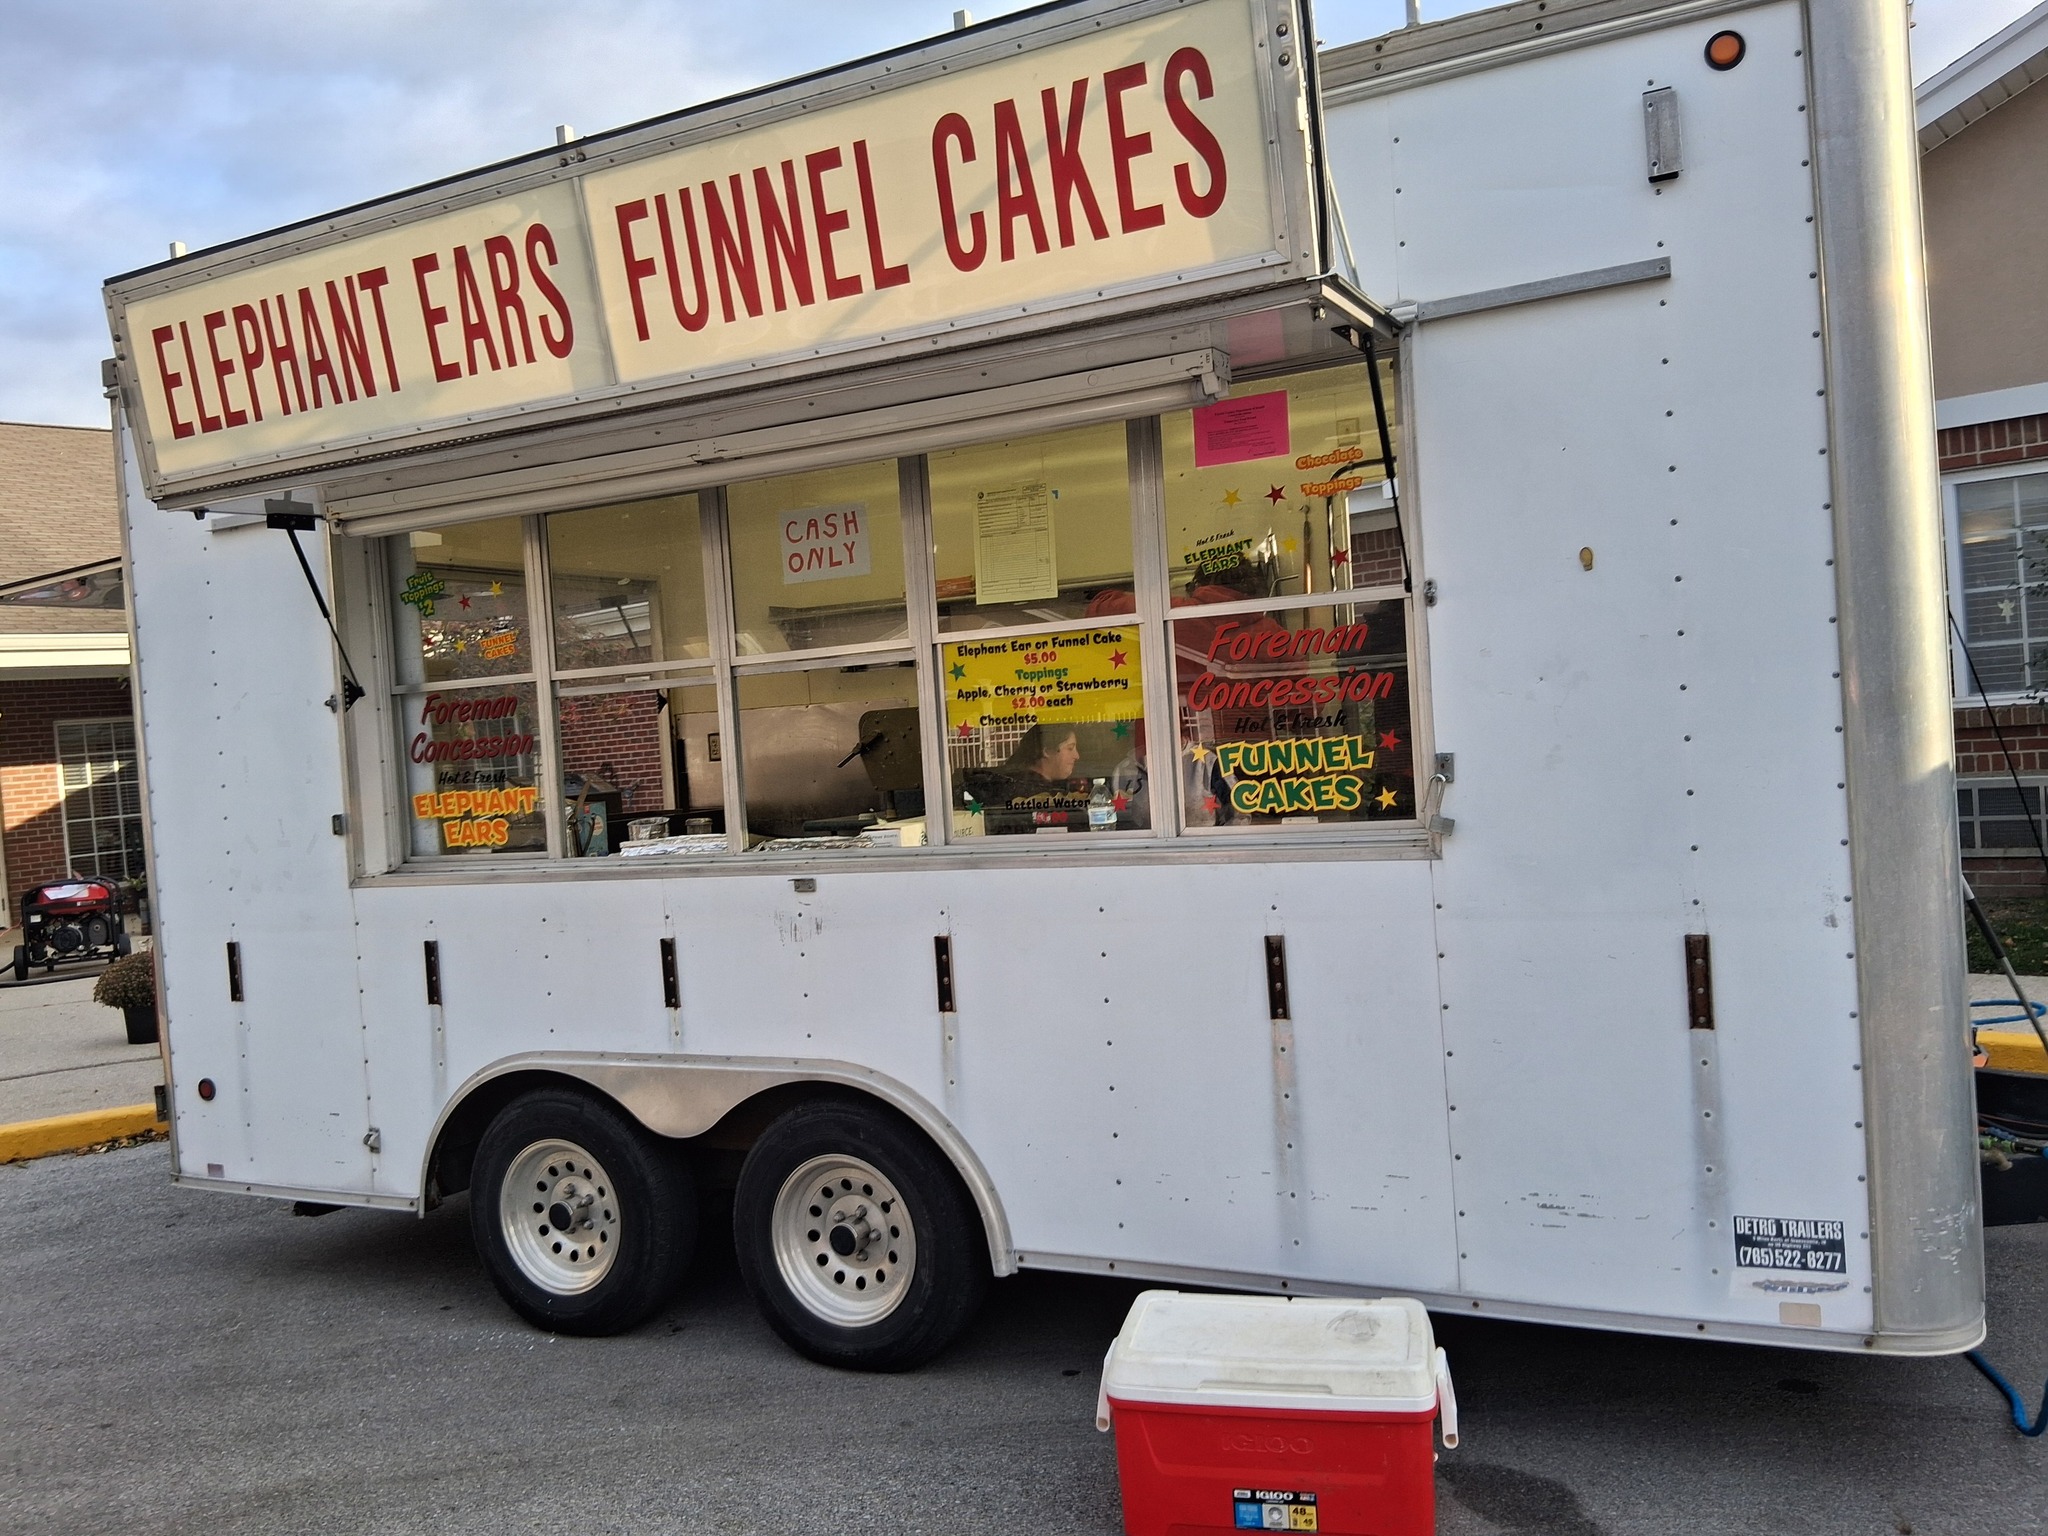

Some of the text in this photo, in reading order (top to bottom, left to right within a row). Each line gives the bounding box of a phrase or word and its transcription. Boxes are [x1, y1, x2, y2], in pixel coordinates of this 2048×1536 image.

[616, 47, 1227, 341] FUNNEL CAKES
[152, 224, 574, 439] ELEPHANT EARS
[1296, 446, 1363, 470] Chocolate
[1300, 477, 1362, 497] Toppings
[786, 510, 859, 543] CASH
[788, 541, 855, 573] ONLY
[1184, 538, 1253, 565] ELEPHANT
[1201, 554, 1240, 576] EARS
[400, 579, 445, 605] Toppings
[407, 571, 433, 590] Fruit
[480, 632, 518, 650] FUNNEL
[484, 644, 515, 660] CAKES
[957, 631, 1122, 659] Elephant Ear or Funnel Cake
[1206, 621, 1368, 663] Foreman
[1024, 651, 1057, 666] $5.00
[1015, 666, 1069, 682] Toppings
[957, 677, 1129, 701] Apple, Cherry or Strawberry
[1188, 666, 1395, 711] Concession
[422, 693, 518, 725] Foreman
[1012, 695, 1073, 709] $2.00 each
[980, 713, 1037, 727] Chocolate
[1235, 709, 1348, 734] Hot & Fresh
[411, 727, 534, 764] Concession
[1216, 734, 1375, 778] FUNNEL
[439, 770, 507, 785] Hot & Fresh
[413, 787, 538, 819] ELEPHANT
[1005, 797, 1091, 811] Bottled Water
[1230, 774, 1364, 814] CAKES
[443, 818, 509, 848] EARS
[1736, 1217, 1842, 1240] DETRO TRAILERS
[1222, 1434, 1314, 1454] IGLOO
[1255, 1490, 1294, 1501] IGLOO
